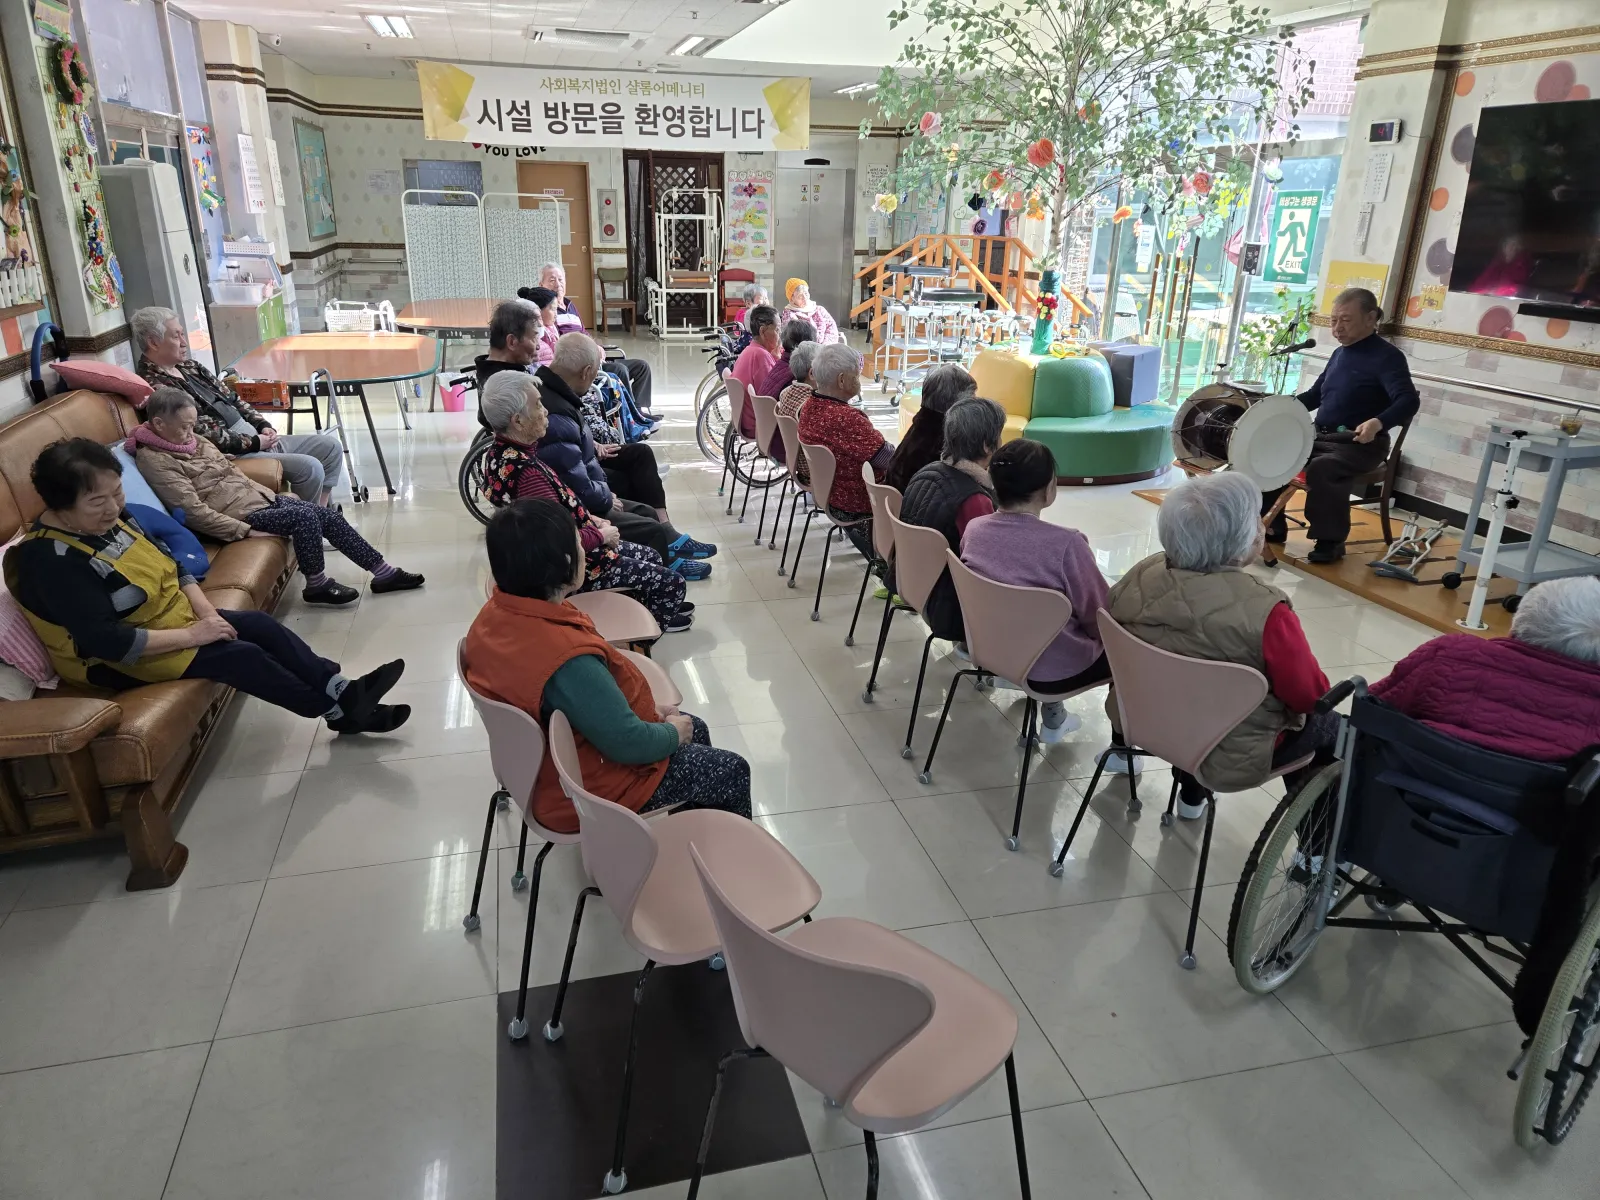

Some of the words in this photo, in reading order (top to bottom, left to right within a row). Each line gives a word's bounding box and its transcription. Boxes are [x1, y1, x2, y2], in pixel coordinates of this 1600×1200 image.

[540, 77, 621, 95] 사회복지법인
[626, 79, 705, 98] 샬롬어메니티
[477, 98, 532, 133] 시설
[544, 101, 625, 135] 방문을
[635, 103, 765, 139] 환영합니다
[485, 144, 509, 157] YOU
[1285, 260, 1302, 269] EXIT
